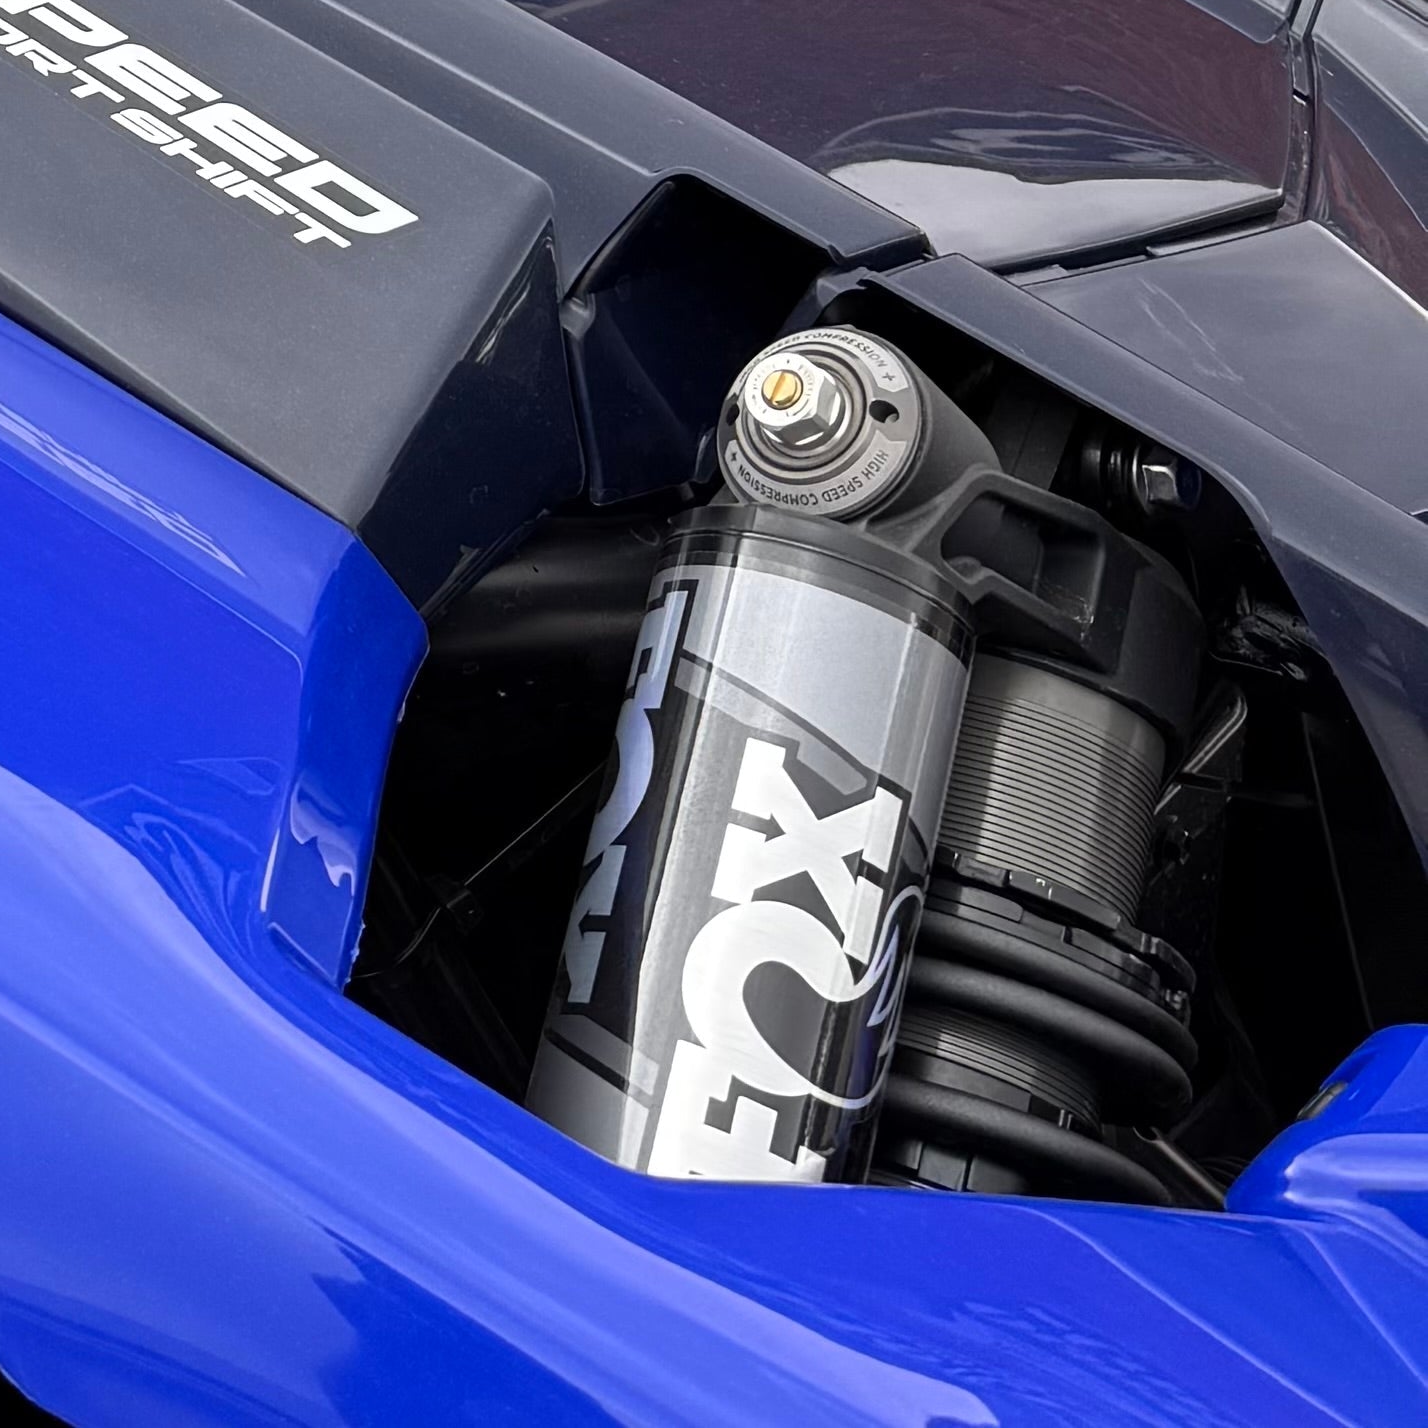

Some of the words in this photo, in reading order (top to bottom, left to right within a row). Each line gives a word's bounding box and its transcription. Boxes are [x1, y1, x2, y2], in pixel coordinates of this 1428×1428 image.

[803, 331, 888, 368] COMPRESSION
[862, 450, 889, 480] HIGH
[738, 465, 819, 506] COMPRESSION
[821, 475, 864, 504] SPEED
[647, 737, 916, 1182] FOX
